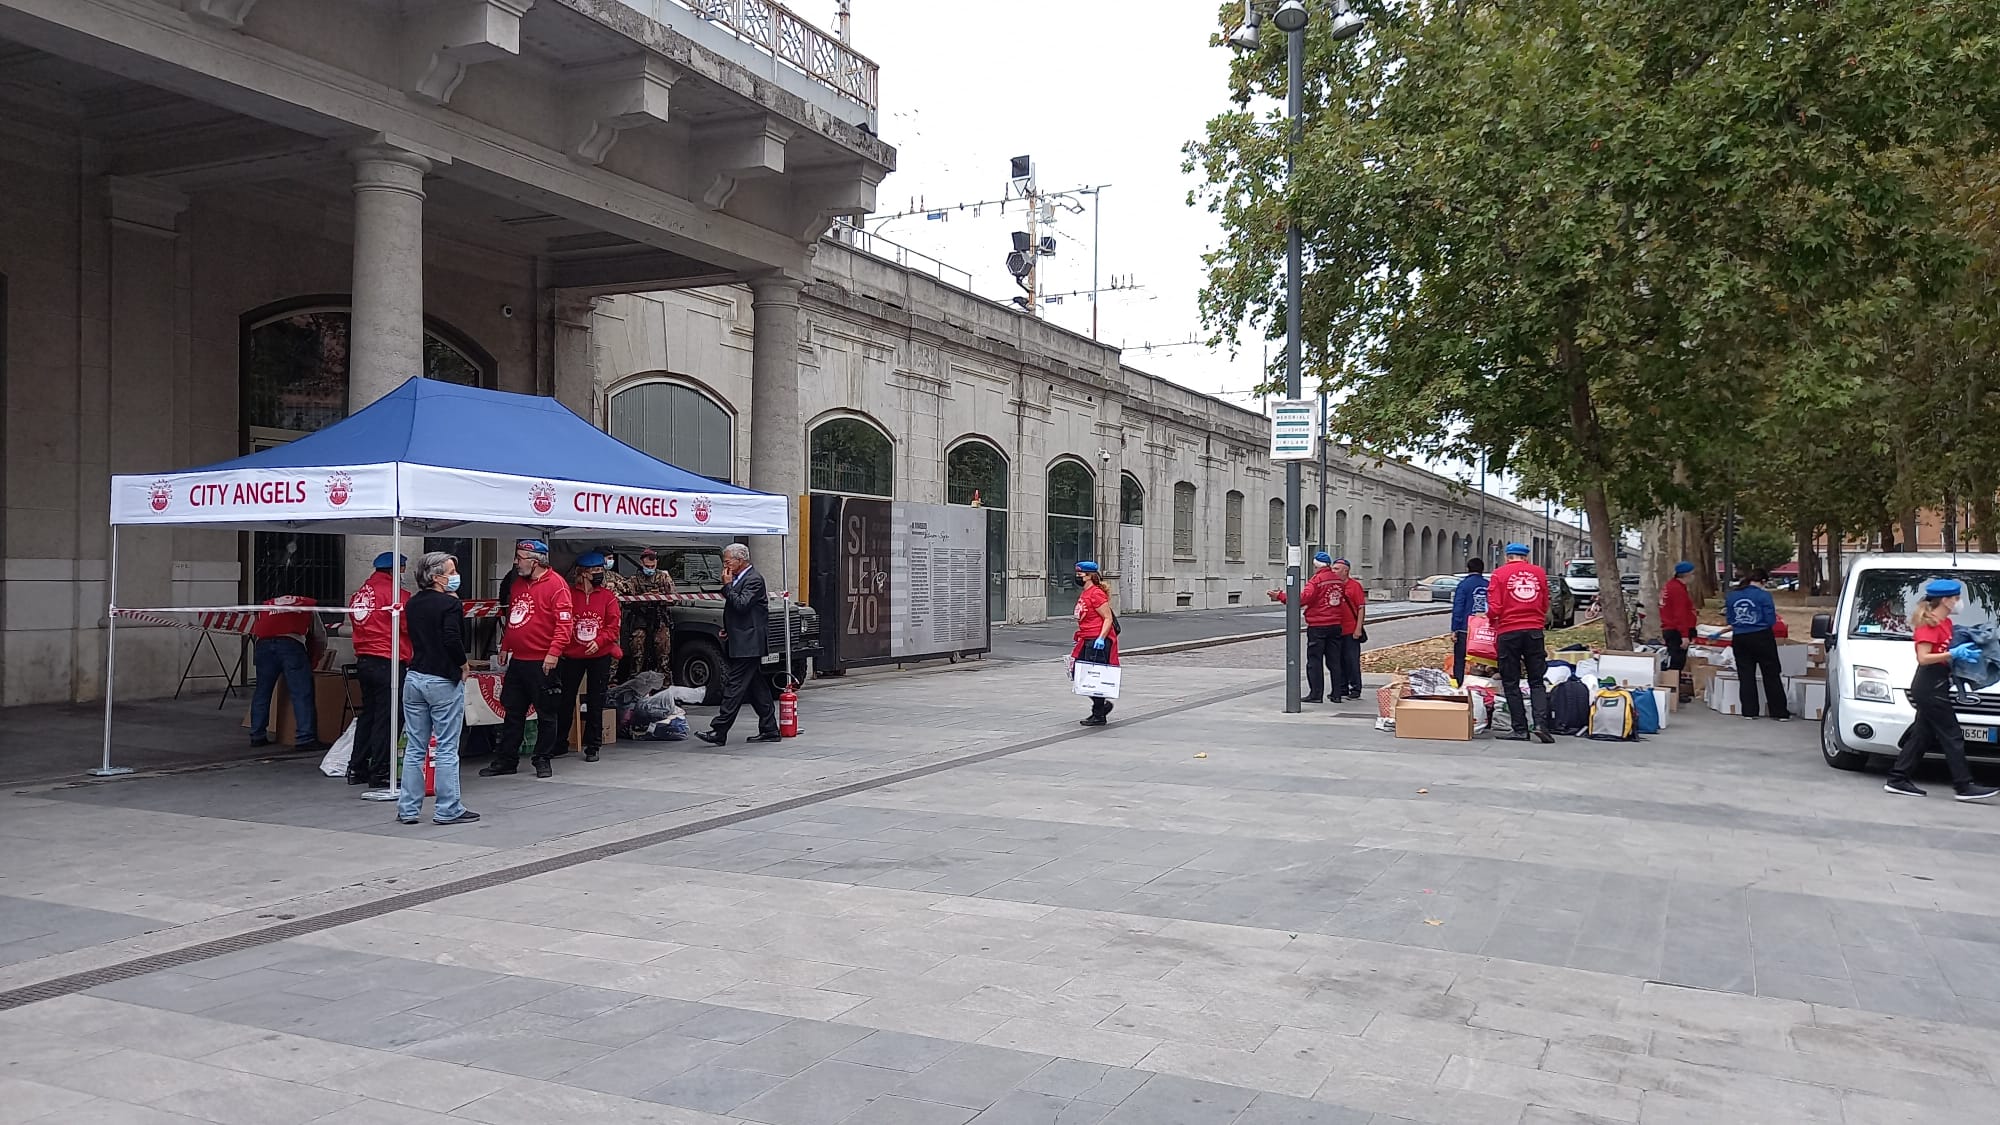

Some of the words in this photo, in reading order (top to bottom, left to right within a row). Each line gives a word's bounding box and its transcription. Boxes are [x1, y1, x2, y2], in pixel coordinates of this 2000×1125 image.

[189, 484, 229, 506] CITY
[232, 481, 306, 504] ANGELS
[574, 491, 614, 513] CITY
[616, 495, 678, 518] ANGELS
[847, 514, 867, 555] SI
[847, 595, 878, 635] ZIO
